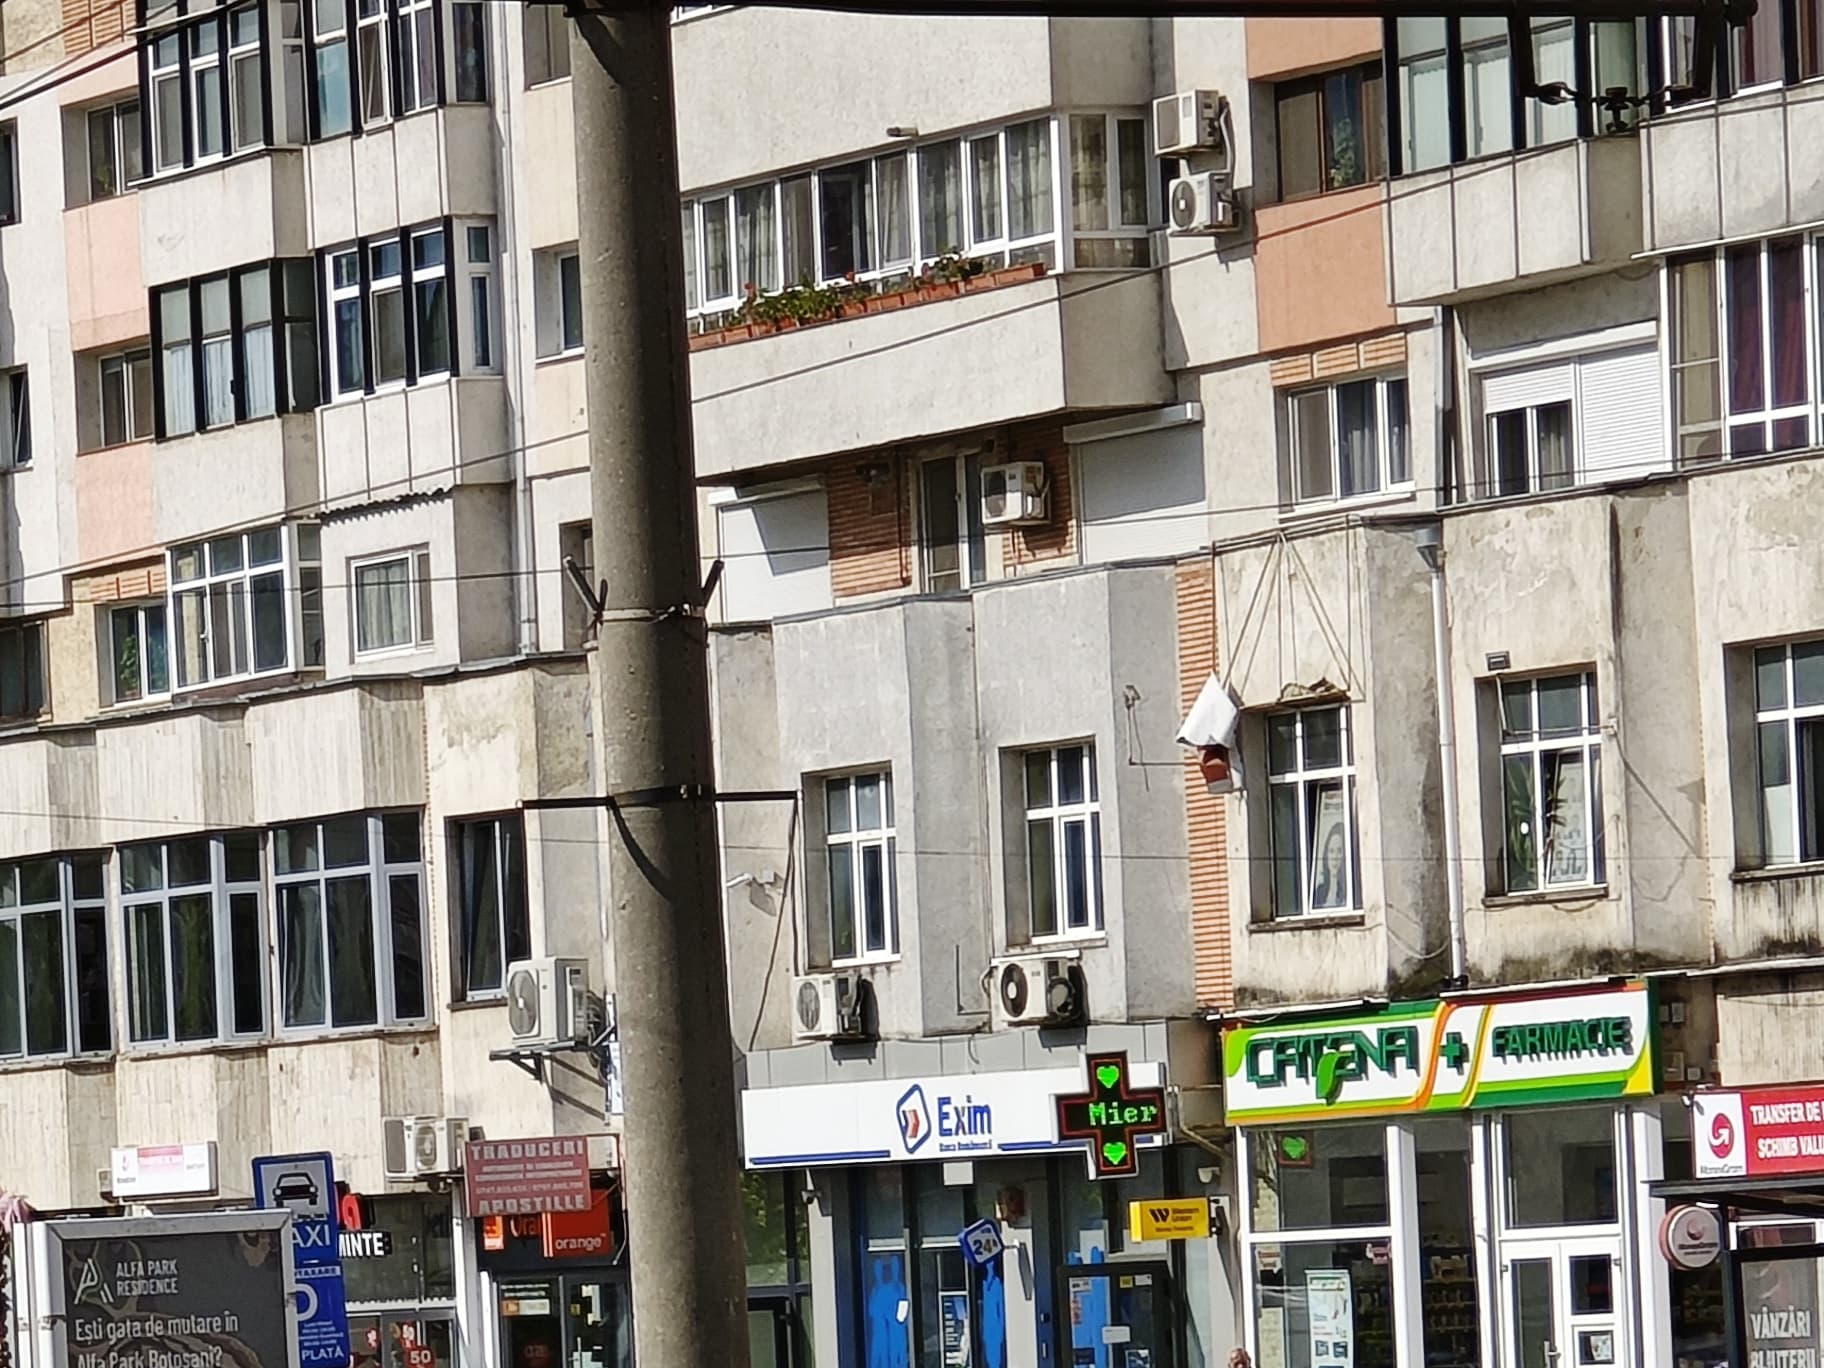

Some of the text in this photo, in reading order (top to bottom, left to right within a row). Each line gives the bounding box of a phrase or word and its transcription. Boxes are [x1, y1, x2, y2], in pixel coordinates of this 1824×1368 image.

[1492, 1016, 1634, 1065] FARMACIE
[1245, 1023, 1419, 1106] CATENA
[938, 1095, 992, 1138] Exim
[1088, 1101, 1158, 1127] Mier
[1750, 1100, 1822, 1125] TRANSFER DE
[471, 1140, 584, 1161] TRADUCERI
[1757, 1138, 1798, 1159] SCHIMB
[478, 1194, 585, 1215] APOSTILLE
[292, 1224, 331, 1248] AXI
[555, 1236, 602, 1251] orange
[116, 1259, 178, 1278] ALFA PARK
[116, 1278, 178, 1297] RESIDENCE
[107, 1321, 141, 1345] gata
[145, 1314, 164, 1338] de
[167, 1314, 222, 1337] mutare
[410, 1350, 431, 1364] 50
